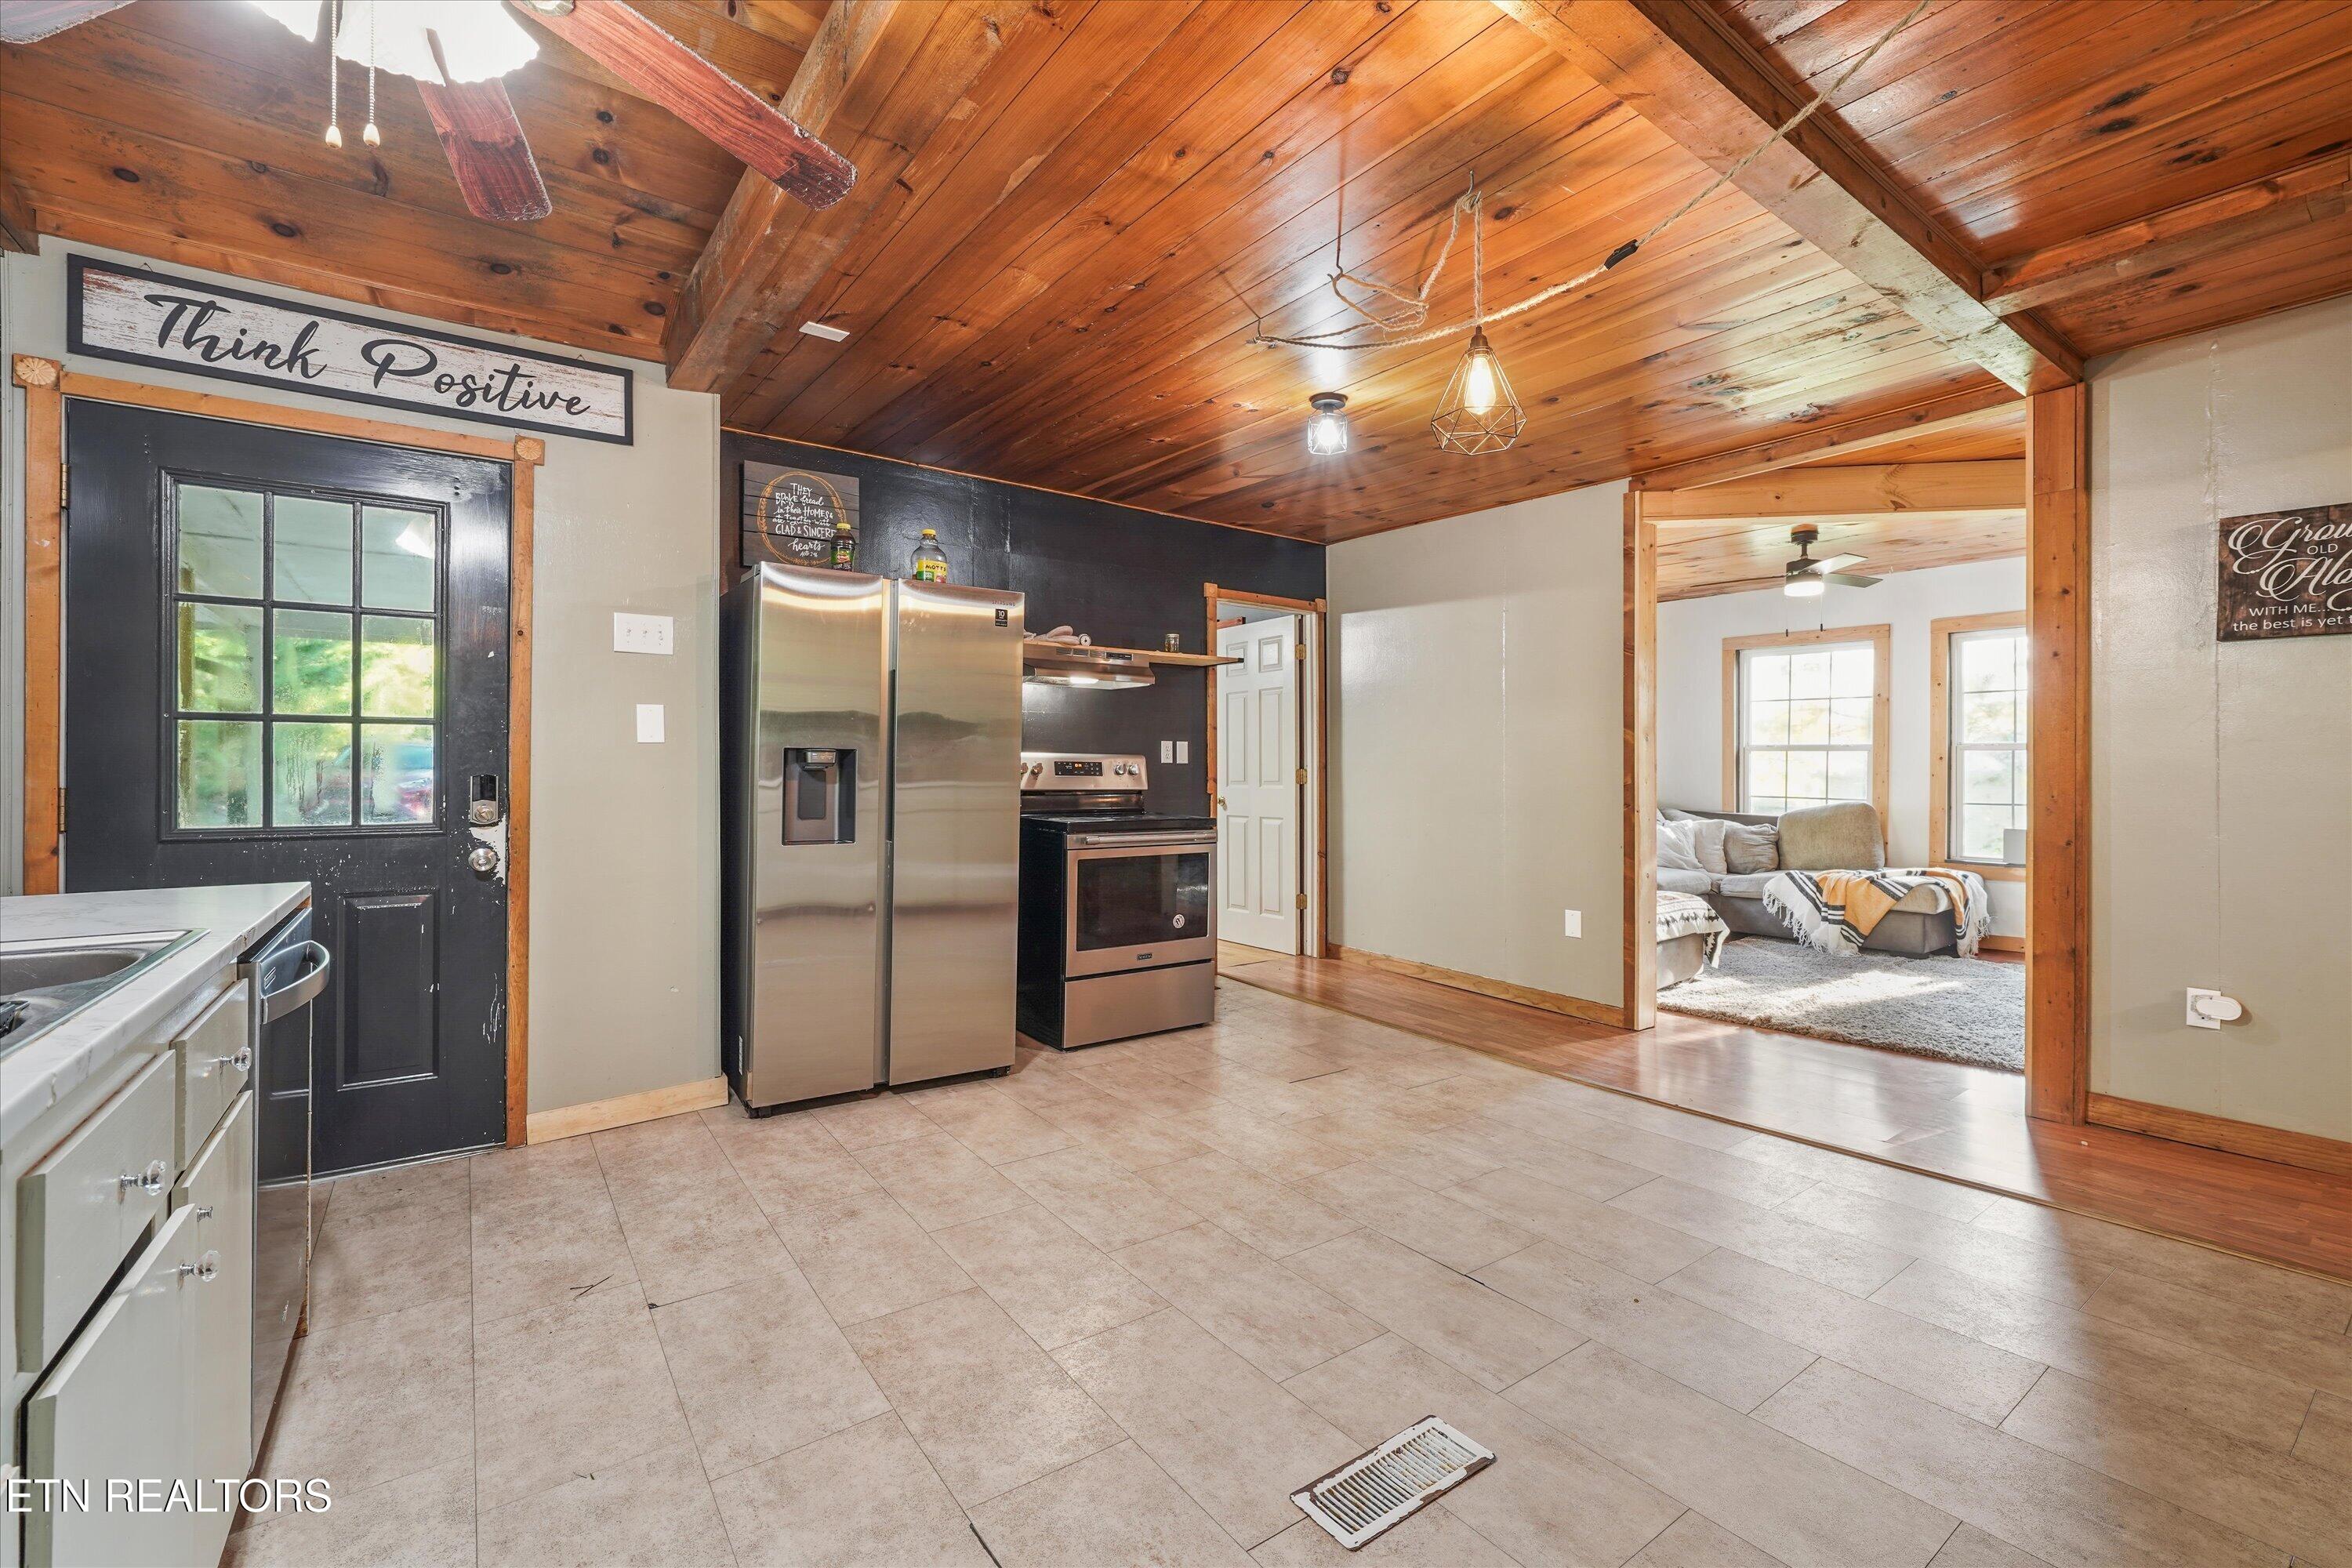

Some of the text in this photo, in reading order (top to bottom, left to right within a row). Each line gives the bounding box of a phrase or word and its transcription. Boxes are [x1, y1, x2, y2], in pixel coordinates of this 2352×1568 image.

[144, 294, 591, 416] Think Positive
[790, 483, 812, 497] THEY
[803, 506, 829, 519] HOMES
[775, 524, 796, 535] GLAD
[797, 526, 802, 535] &
[787, 538, 825, 551] hearts
[2307, 543, 2338, 555] OLD
[2249, 605, 2288, 617] WITH
[2233, 621, 2258, 631] the
[2263, 619, 2296, 630] best
[2301, 617, 2313, 627] is
[2318, 615, 2344, 628] yet
